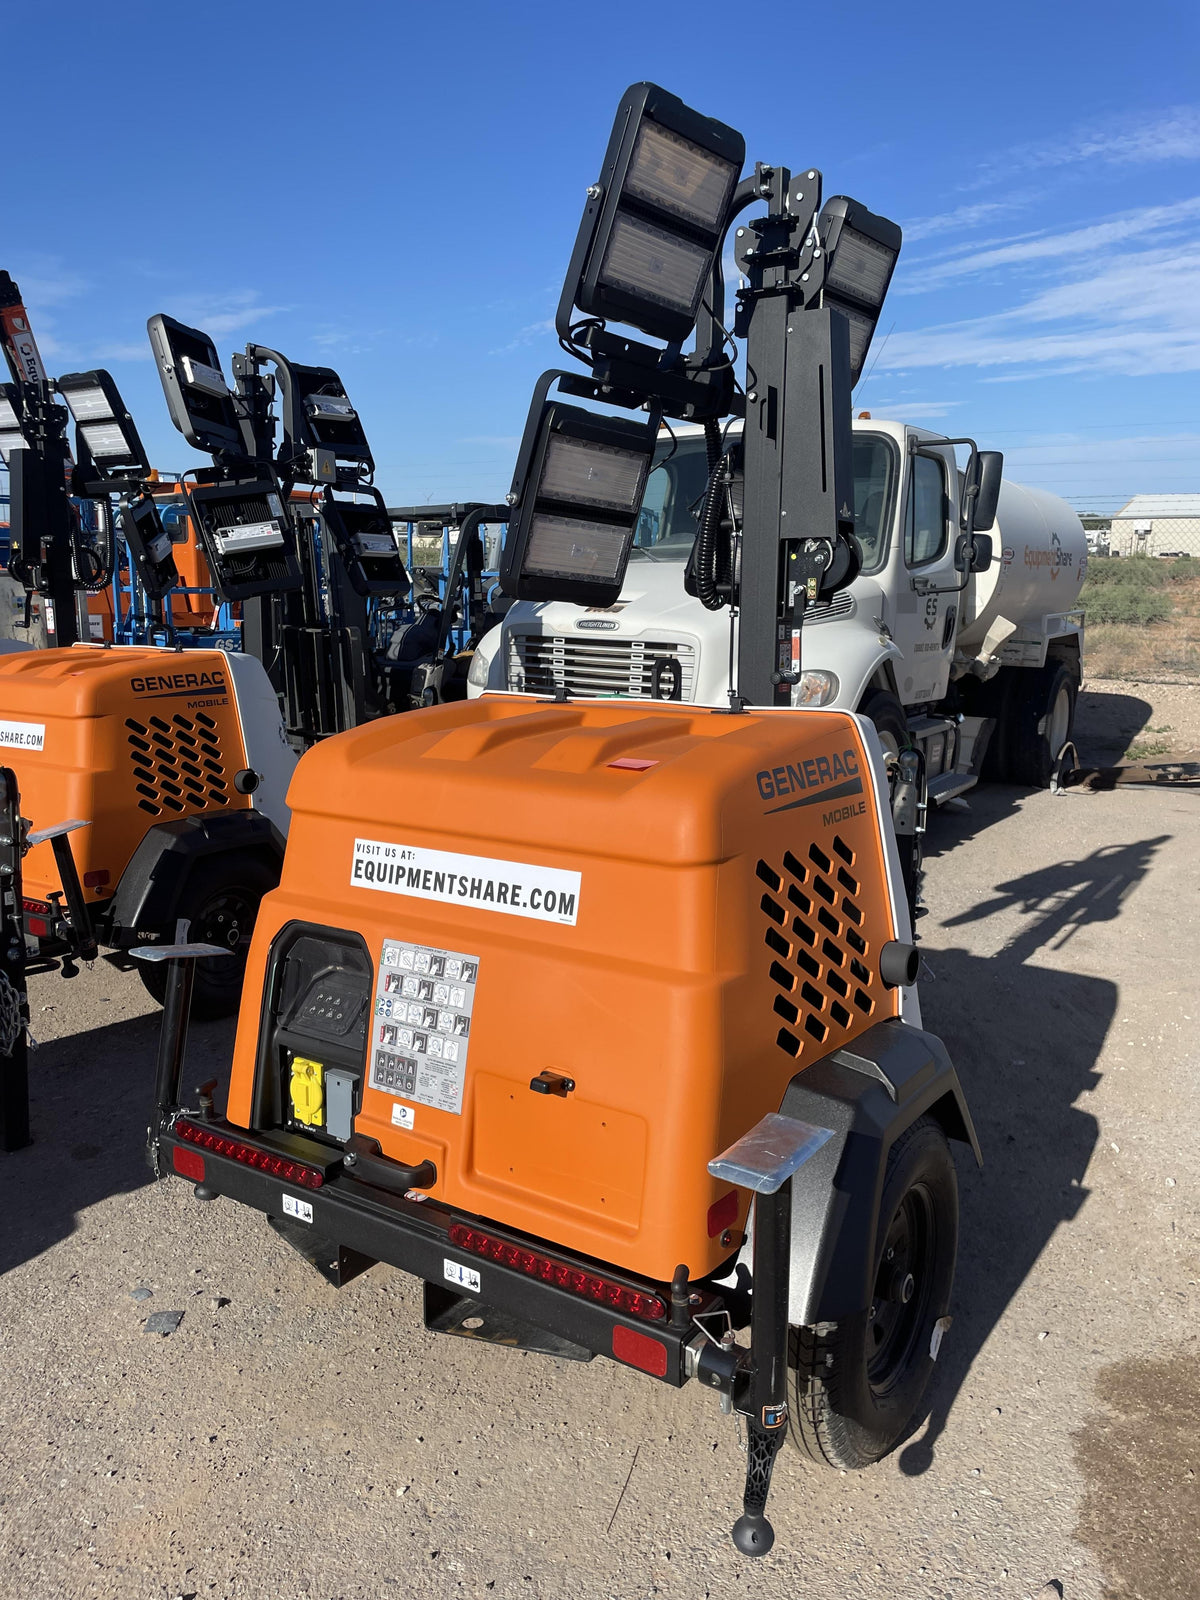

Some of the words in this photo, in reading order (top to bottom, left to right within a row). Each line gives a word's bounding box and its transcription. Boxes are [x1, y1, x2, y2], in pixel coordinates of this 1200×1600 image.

[26, 358, 39, 382] Equ
[130, 671, 225, 692] GENERAC
[187, 698, 229, 709] MOBILE
[756, 749, 859, 800] GENERAC
[822, 801, 867, 827] MOBILE
[356, 843, 381, 855] VISIT
[385, 847, 397, 858] US
[400, 850, 415, 860] AT:
[354, 858, 576, 916] EQUIPMENTSHARE.COM
